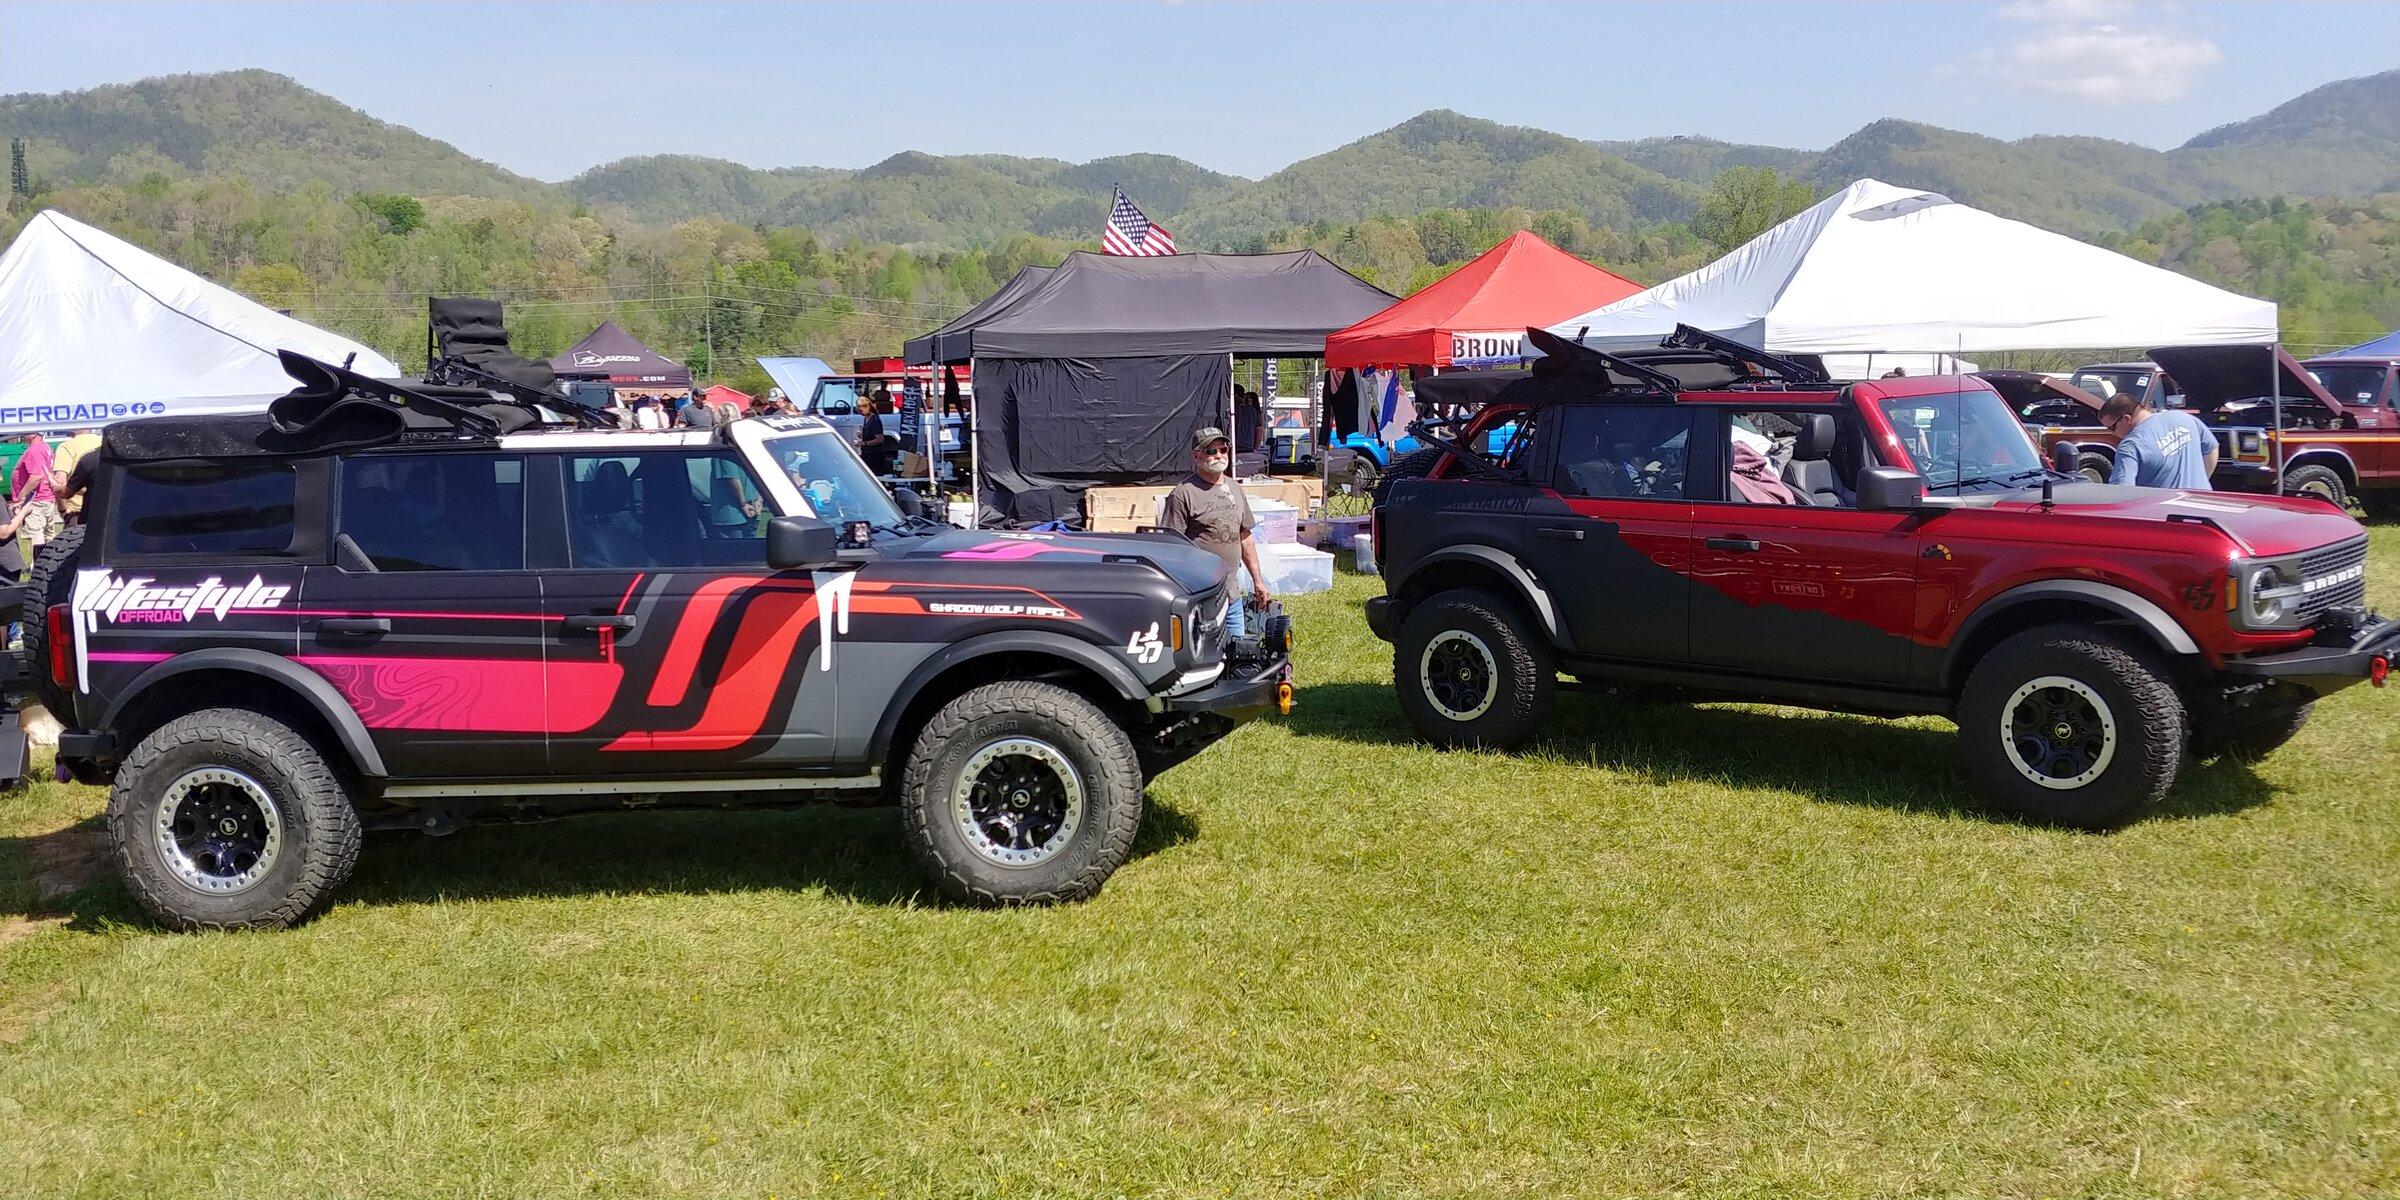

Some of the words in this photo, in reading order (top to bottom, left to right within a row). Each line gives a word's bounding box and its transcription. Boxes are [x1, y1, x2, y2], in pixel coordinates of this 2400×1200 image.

[2302, 564, 2363, 592] BRONCO
[79, 569, 292, 624] lifestyle
[118, 609, 183, 623] OFFROAD
[985, 604, 1025, 615] WOLF
[1026, 605, 1066, 617] MFG
